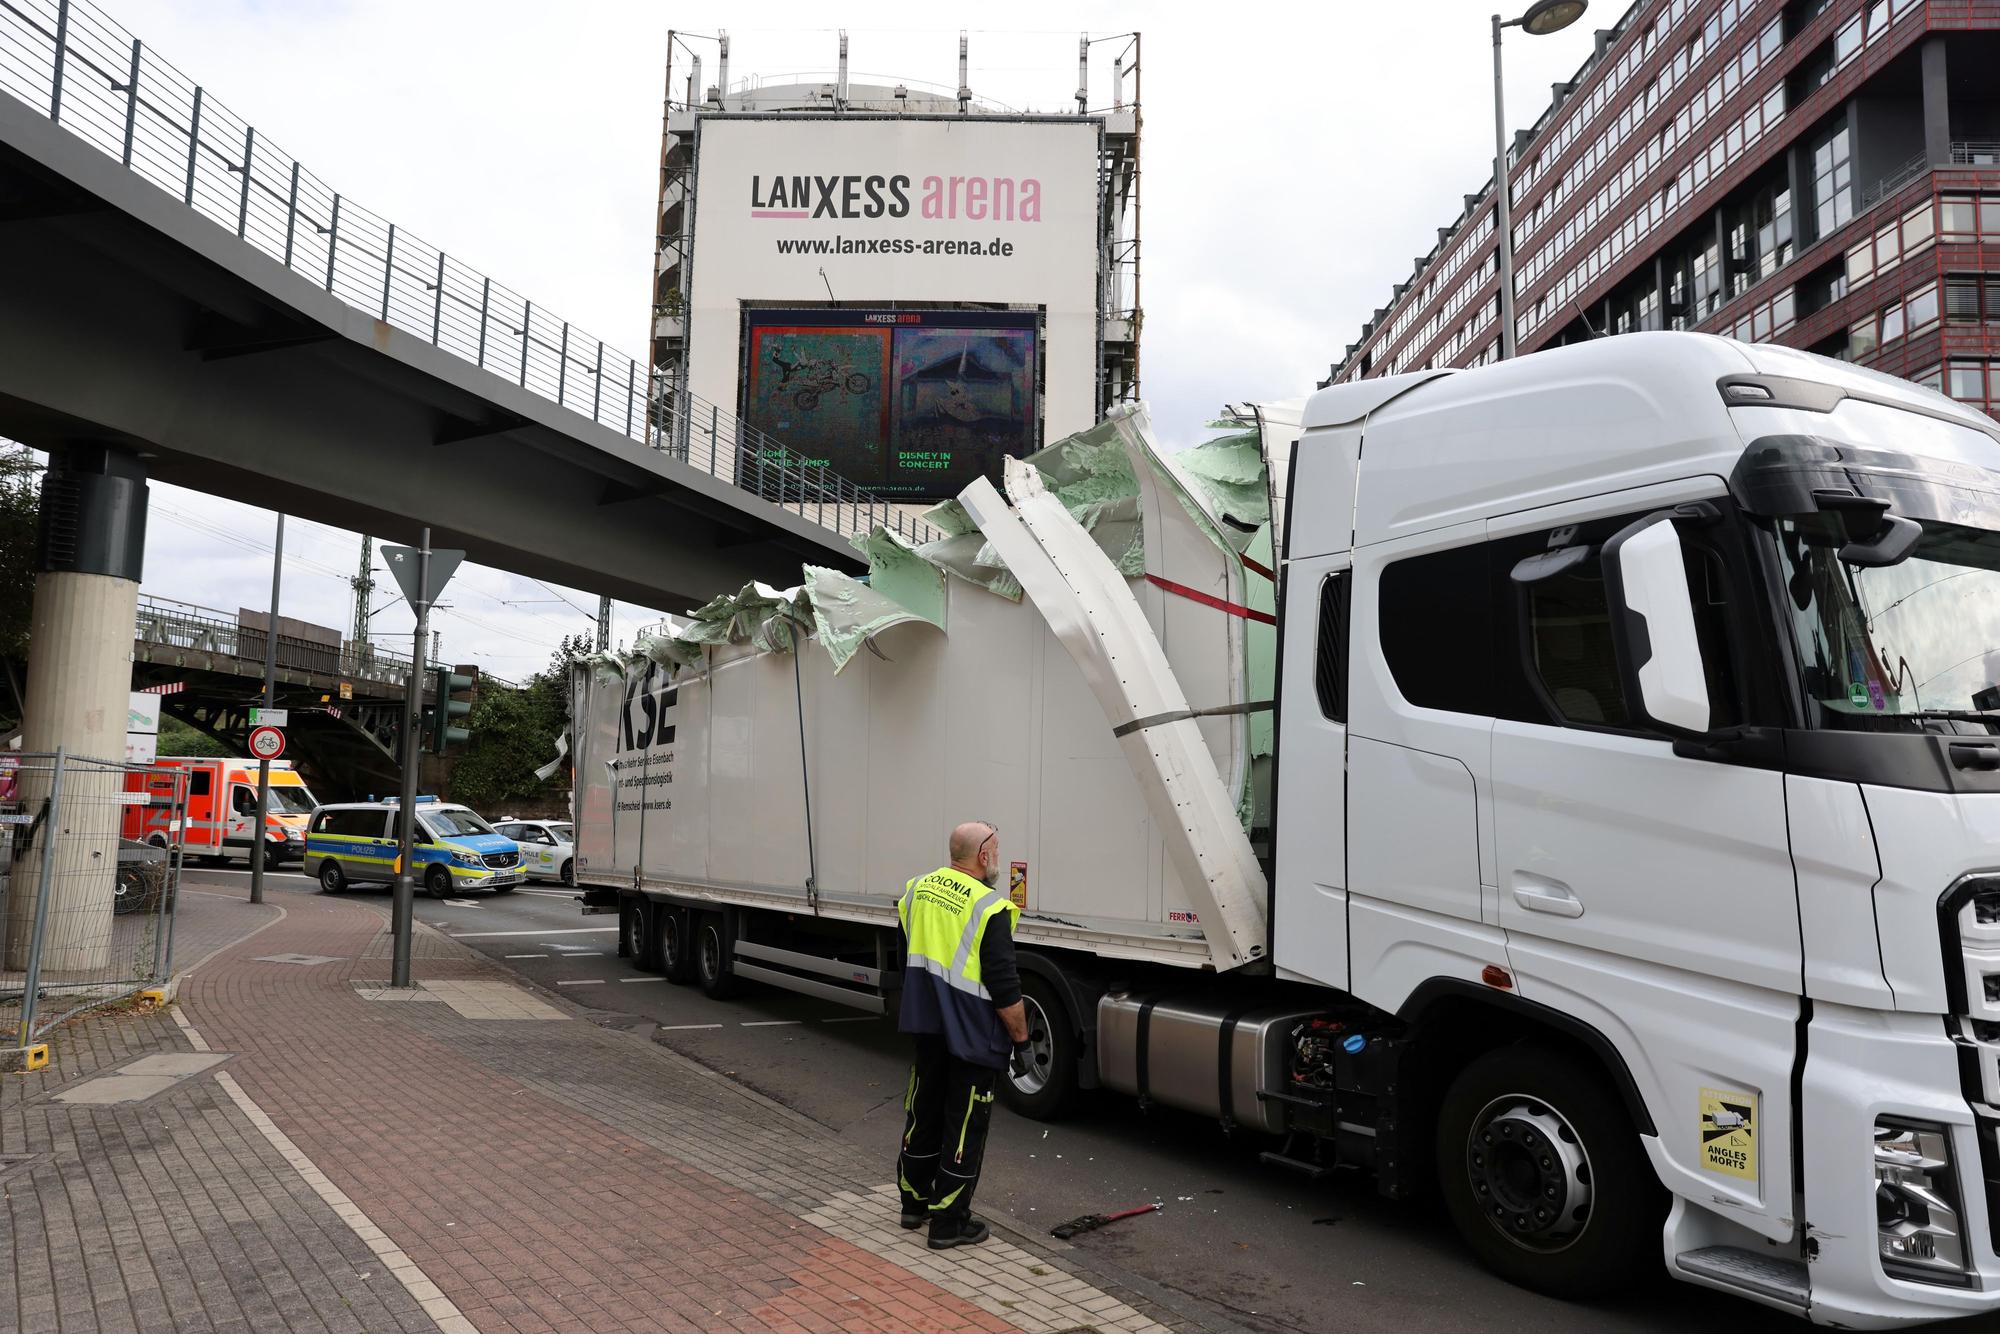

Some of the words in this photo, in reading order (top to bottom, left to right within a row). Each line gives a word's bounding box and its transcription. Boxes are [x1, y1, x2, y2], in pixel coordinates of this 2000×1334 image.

[752, 175, 910, 219] LANXESS
[921, 175, 1042, 222] arena
[777, 236, 1014, 257] www.lanxess-arena.de
[865, 314, 896, 323] LANXESS
[897, 314, 921, 323] arena
[899, 452, 937, 460] DISNEY
[899, 461, 950, 469] CONCERT
[616, 660, 681, 753] KSE
[637, 754, 652, 768] Serice
[652, 750, 674, 765] Eisenbach
[625, 776, 633, 787] und
[634, 770, 672, 789] Spedtionslogistik
[352, 845, 376, 855] POLIZEI
[925, 875, 971, 897] COLONIA
[1708, 1145, 1747, 1161] ANGLES
[1710, 1154, 1745, 1170] MORTS
